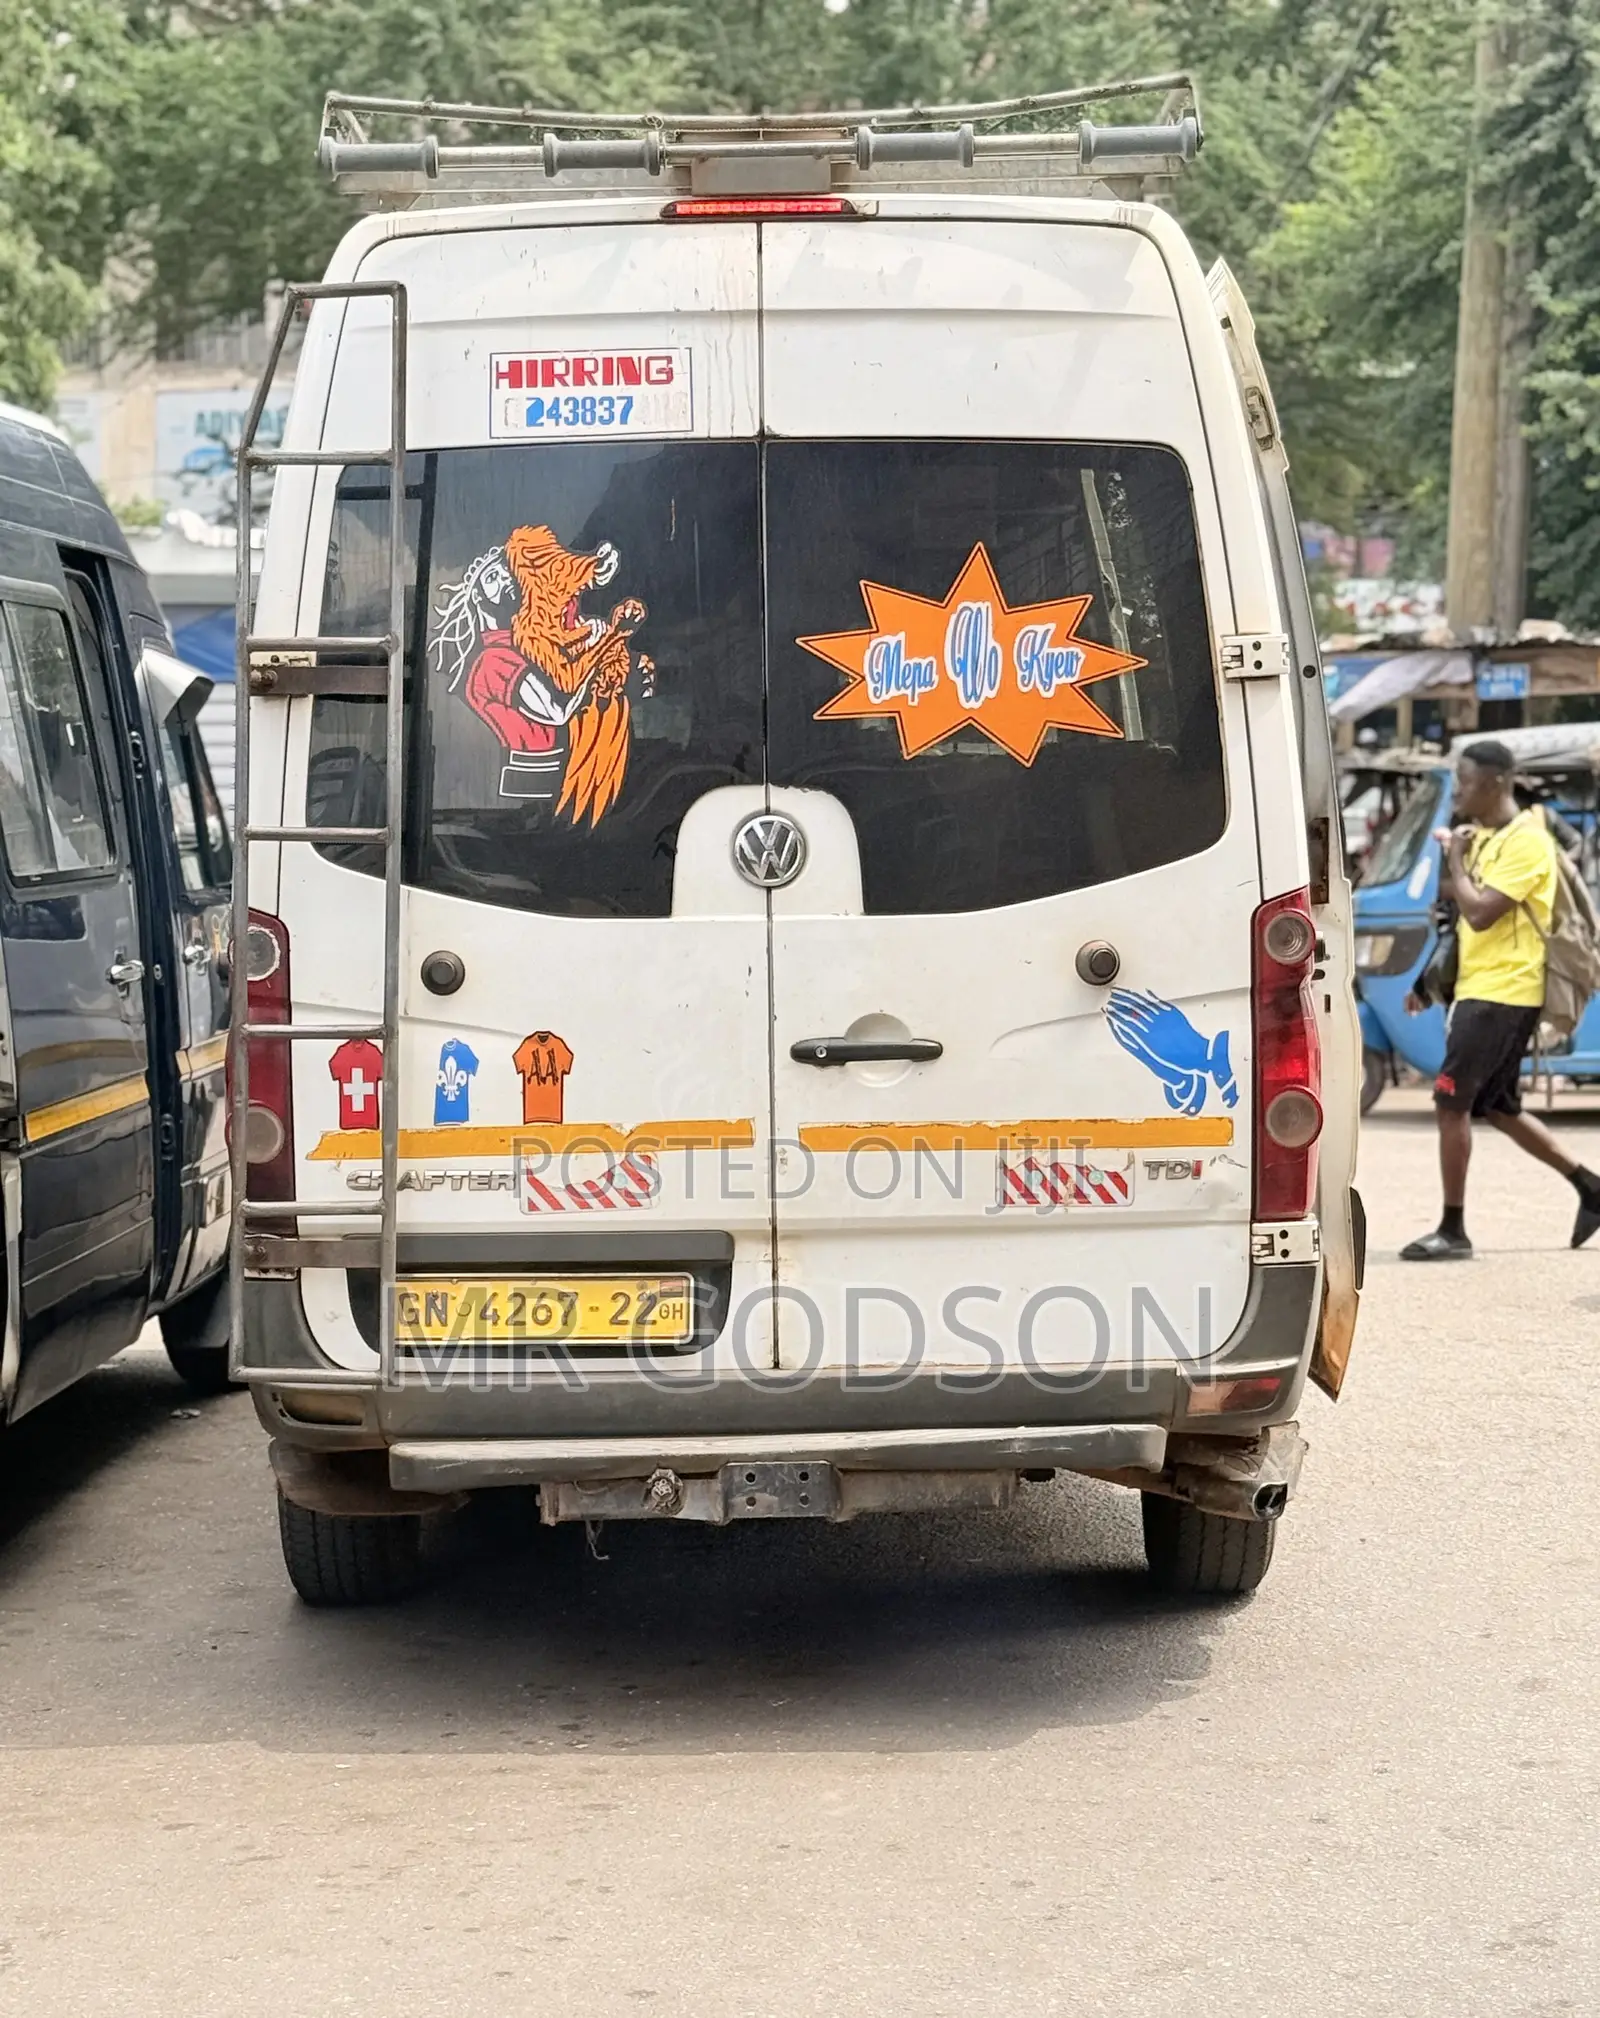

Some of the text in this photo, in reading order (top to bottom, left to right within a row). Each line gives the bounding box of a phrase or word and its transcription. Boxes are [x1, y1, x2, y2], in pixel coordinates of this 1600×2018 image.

[495, 356, 674, 389] HIRRING
[1143, 1157, 1204, 1180] TDI
[398, 1292, 448, 1327] GN
